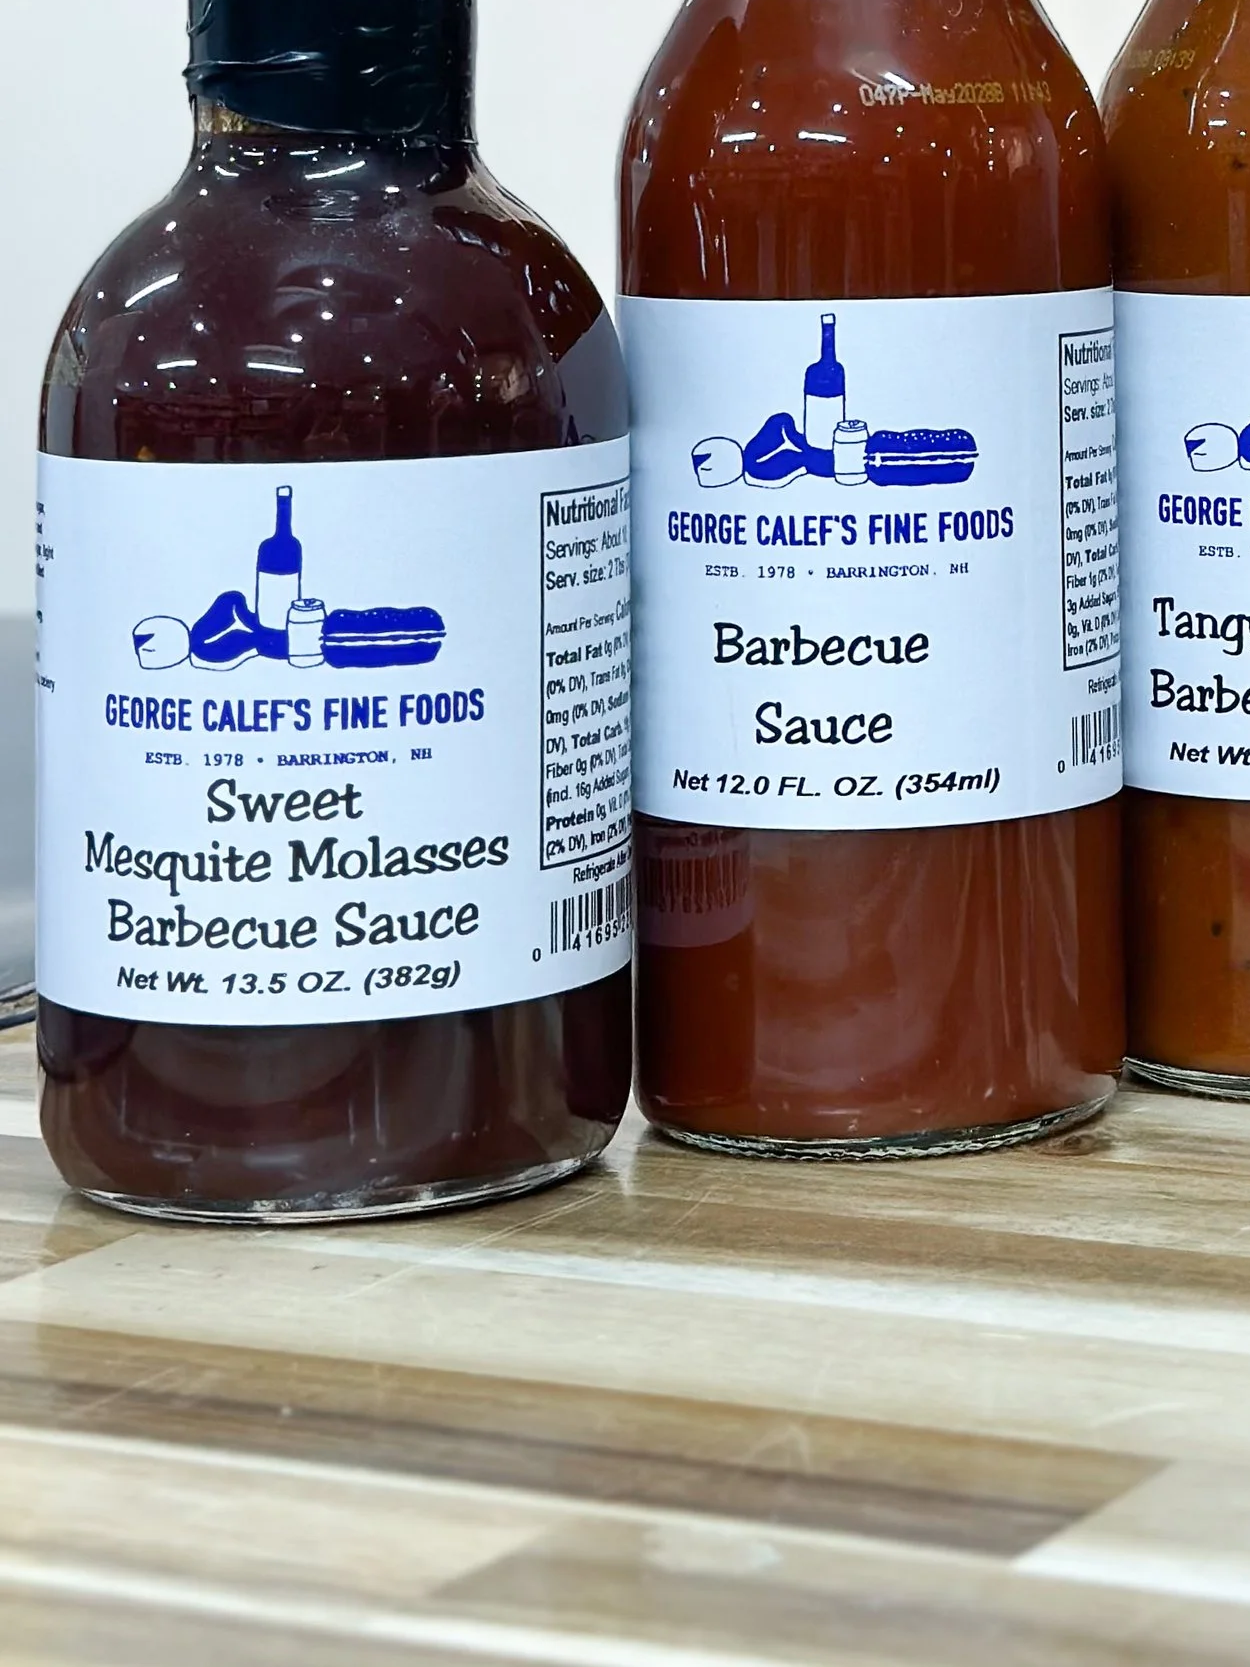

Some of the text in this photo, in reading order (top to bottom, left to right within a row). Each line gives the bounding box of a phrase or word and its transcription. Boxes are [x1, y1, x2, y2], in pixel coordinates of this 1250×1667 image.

[1065, 472, 1092, 490] Total
[547, 490, 618, 527] Nutritional
[1159, 494, 1242, 527] GEORGE
[668, 507, 1013, 546] GEORGE CALEF'S FINE FOODS
[546, 537, 598, 560] Servings:
[1199, 546, 1240, 558] ESTB.
[546, 571, 579, 590] Serv.
[705, 565, 745, 577] ESTB.
[758, 566, 795, 579] 1978
[950, 562, 968, 574] NH
[546, 647, 581, 667] Total
[586, 644, 603, 660] Fat
[713, 622, 929, 666] Barbecue
[106, 688, 484, 732] GEORGE CALEF'S FINE FOODS
[755, 702, 892, 745] Sauce
[571, 729, 601, 749] Total
[145, 748, 432, 766] ESTB. 1978 BARRINGTON, NH
[1170, 742, 1210, 763] Net
[546, 763, 573, 779] Fiber
[1057, 760, 1065, 773] 0
[673, 767, 1000, 800] Net 12.0 FL. OZ. (354ml)
[207, 779, 363, 823] Sweet
[546, 808, 594, 831] Protein
[85, 830, 509, 897] Mesquite Molasses
[108, 898, 479, 950] Barbecue Sauce
[532, 948, 541, 962] 0
[117, 960, 460, 995] Net Wt. 13.5 OZ. (382g)
